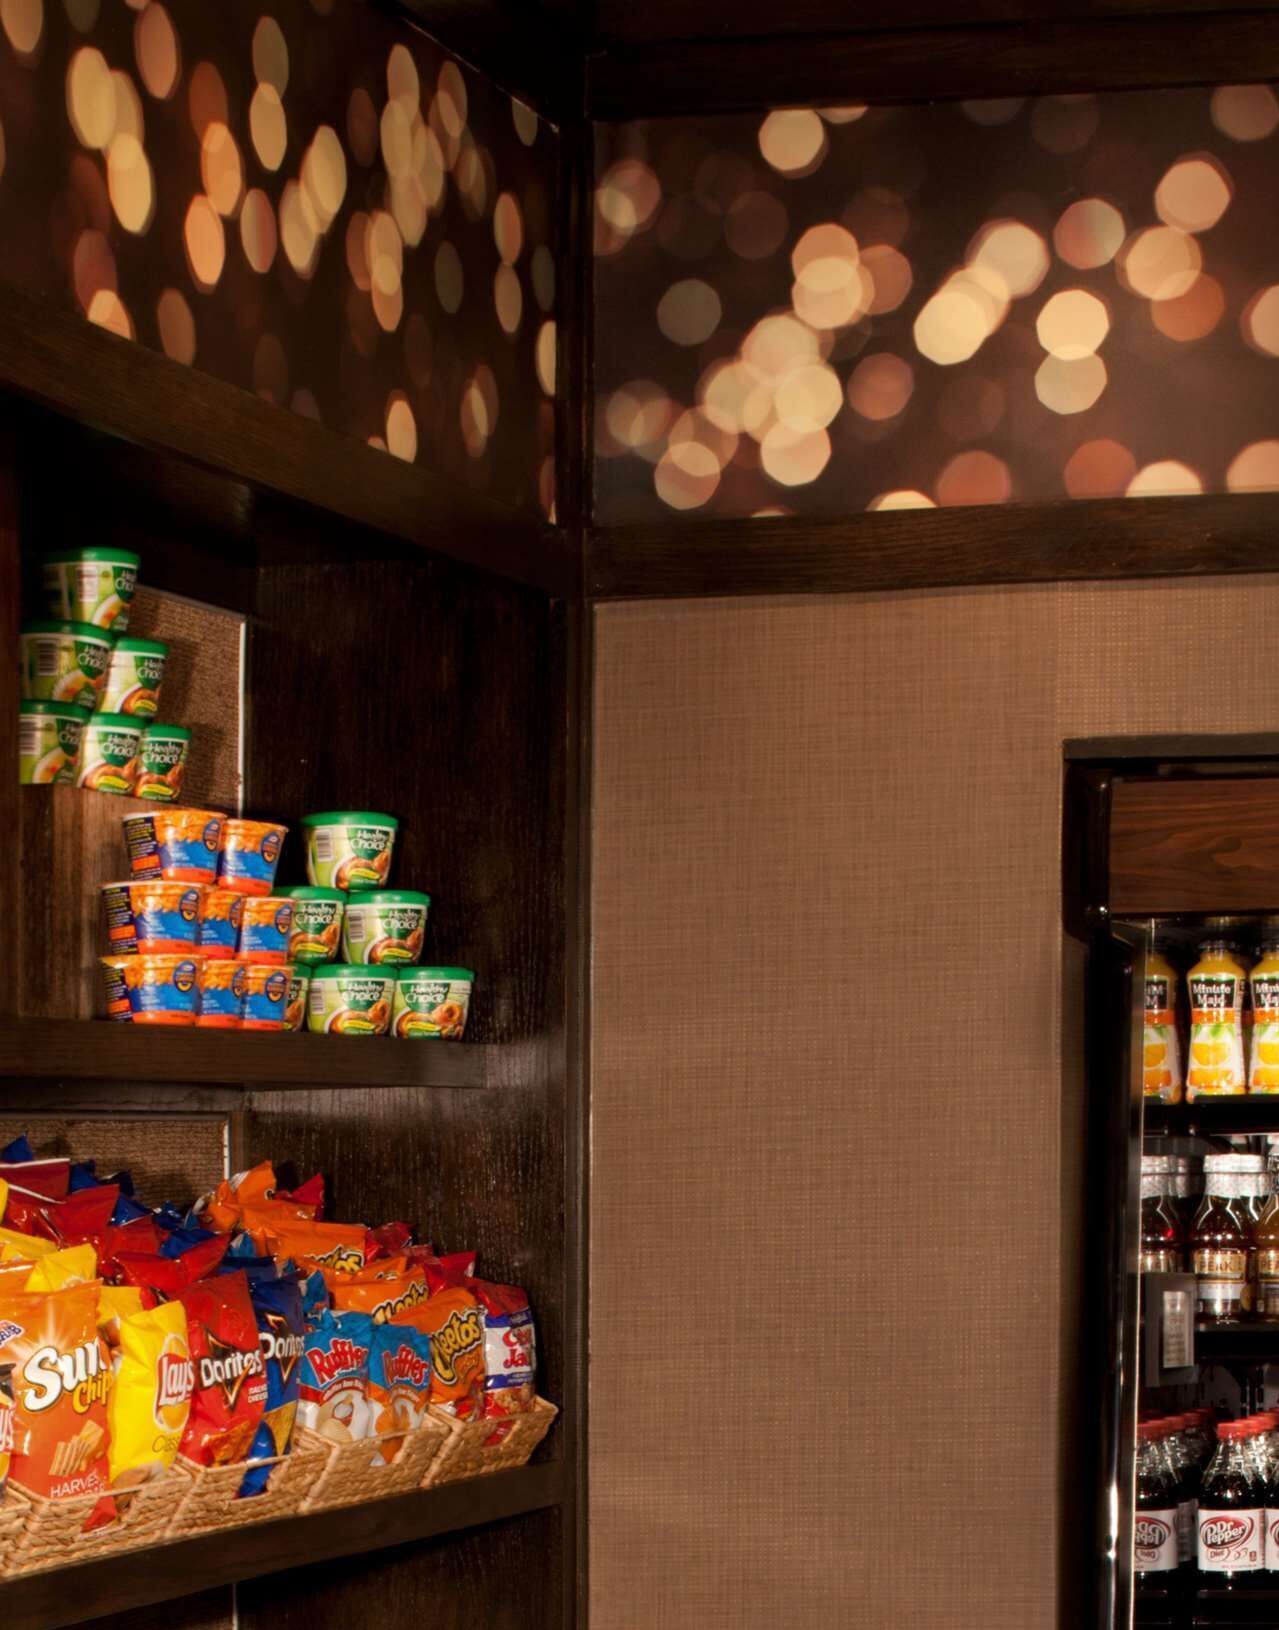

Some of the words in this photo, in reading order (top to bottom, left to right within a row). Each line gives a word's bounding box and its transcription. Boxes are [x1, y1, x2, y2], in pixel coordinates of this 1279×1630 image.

[23, 1337, 108, 1412] Sun
[161, 1354, 194, 1404] Lay's
[200, 1348, 264, 1388] Doritos
[304, 1338, 369, 1385] Ruffles
[382, 1343, 430, 1386] Ruffles
[1204, 1525, 1248, 1544] Pepper
[1221, 1516, 1240, 1531] Dr
